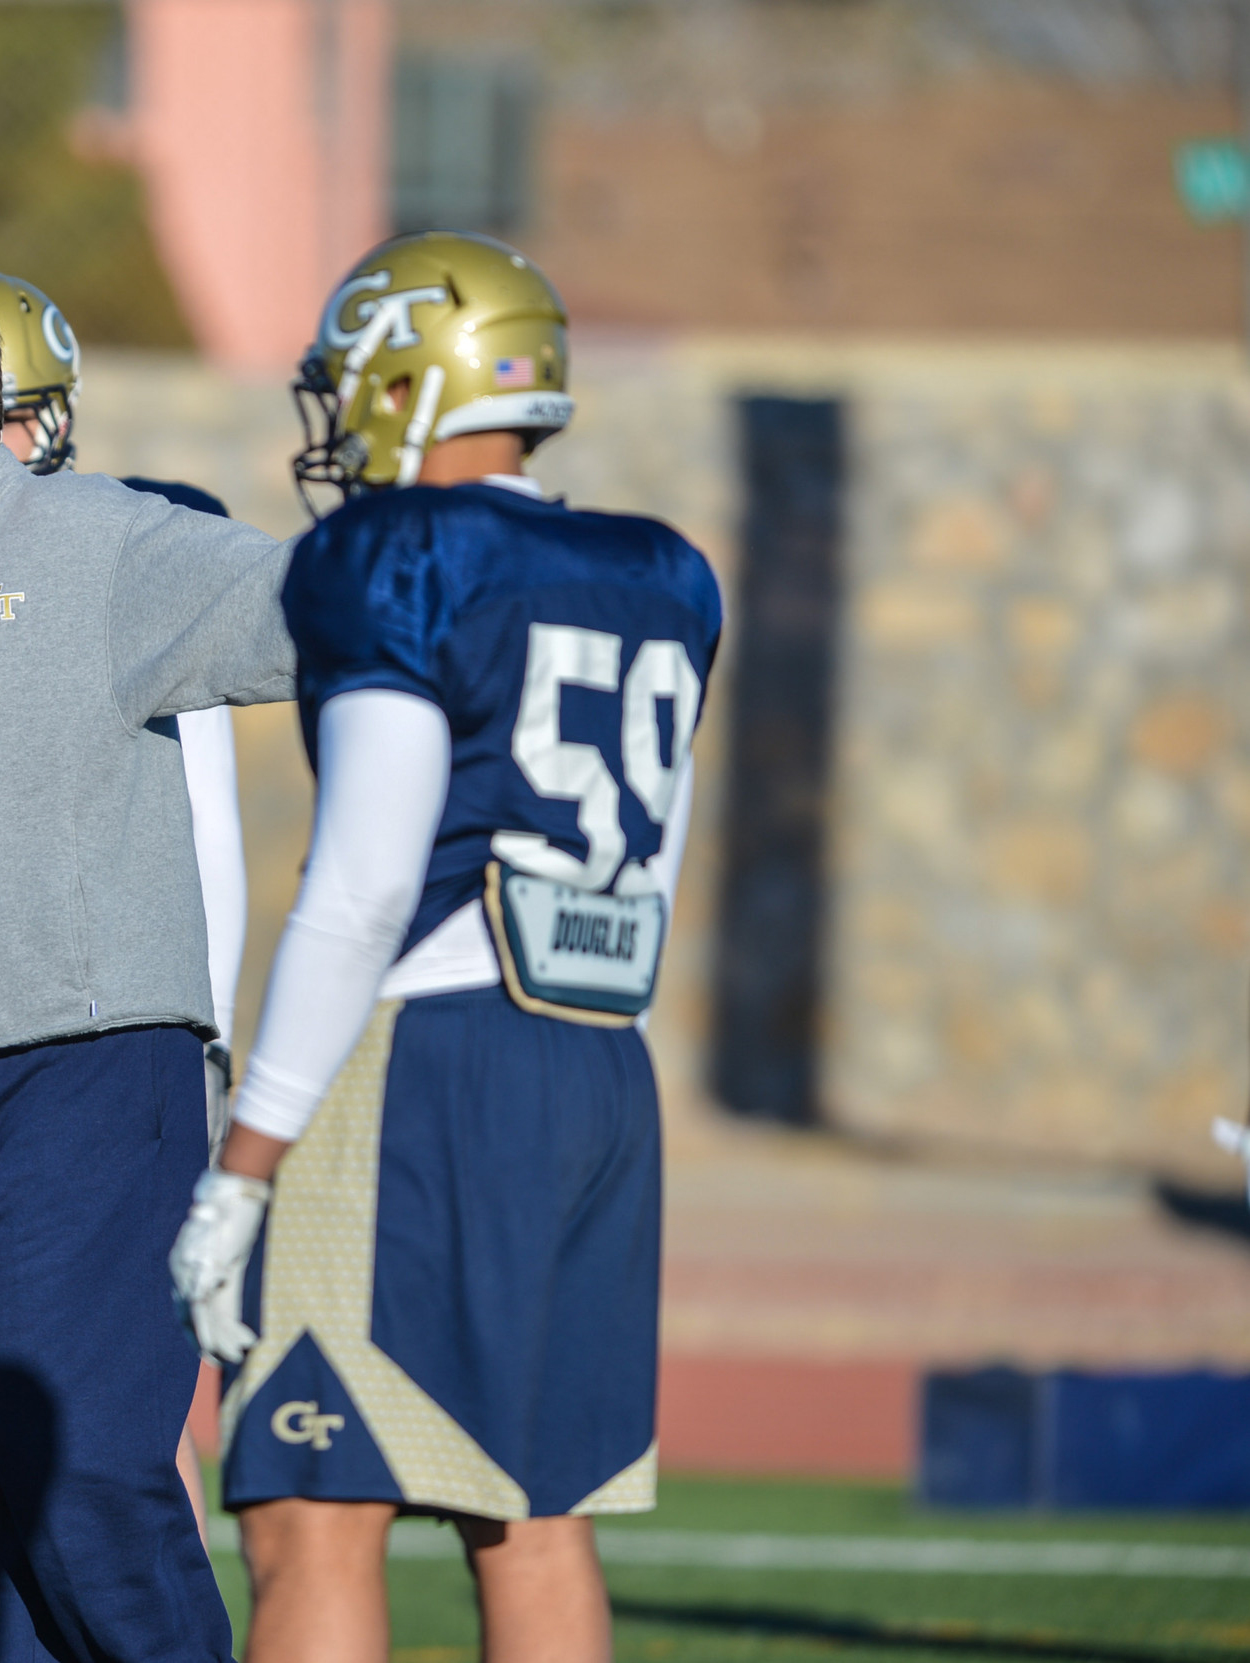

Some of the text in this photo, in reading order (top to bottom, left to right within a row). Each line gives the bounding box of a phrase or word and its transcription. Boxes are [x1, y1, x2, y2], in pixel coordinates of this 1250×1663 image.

[491, 621, 701, 898] 59
[554, 909, 639, 961] DOUGLAS
[270, 1400, 345, 1452] GT
